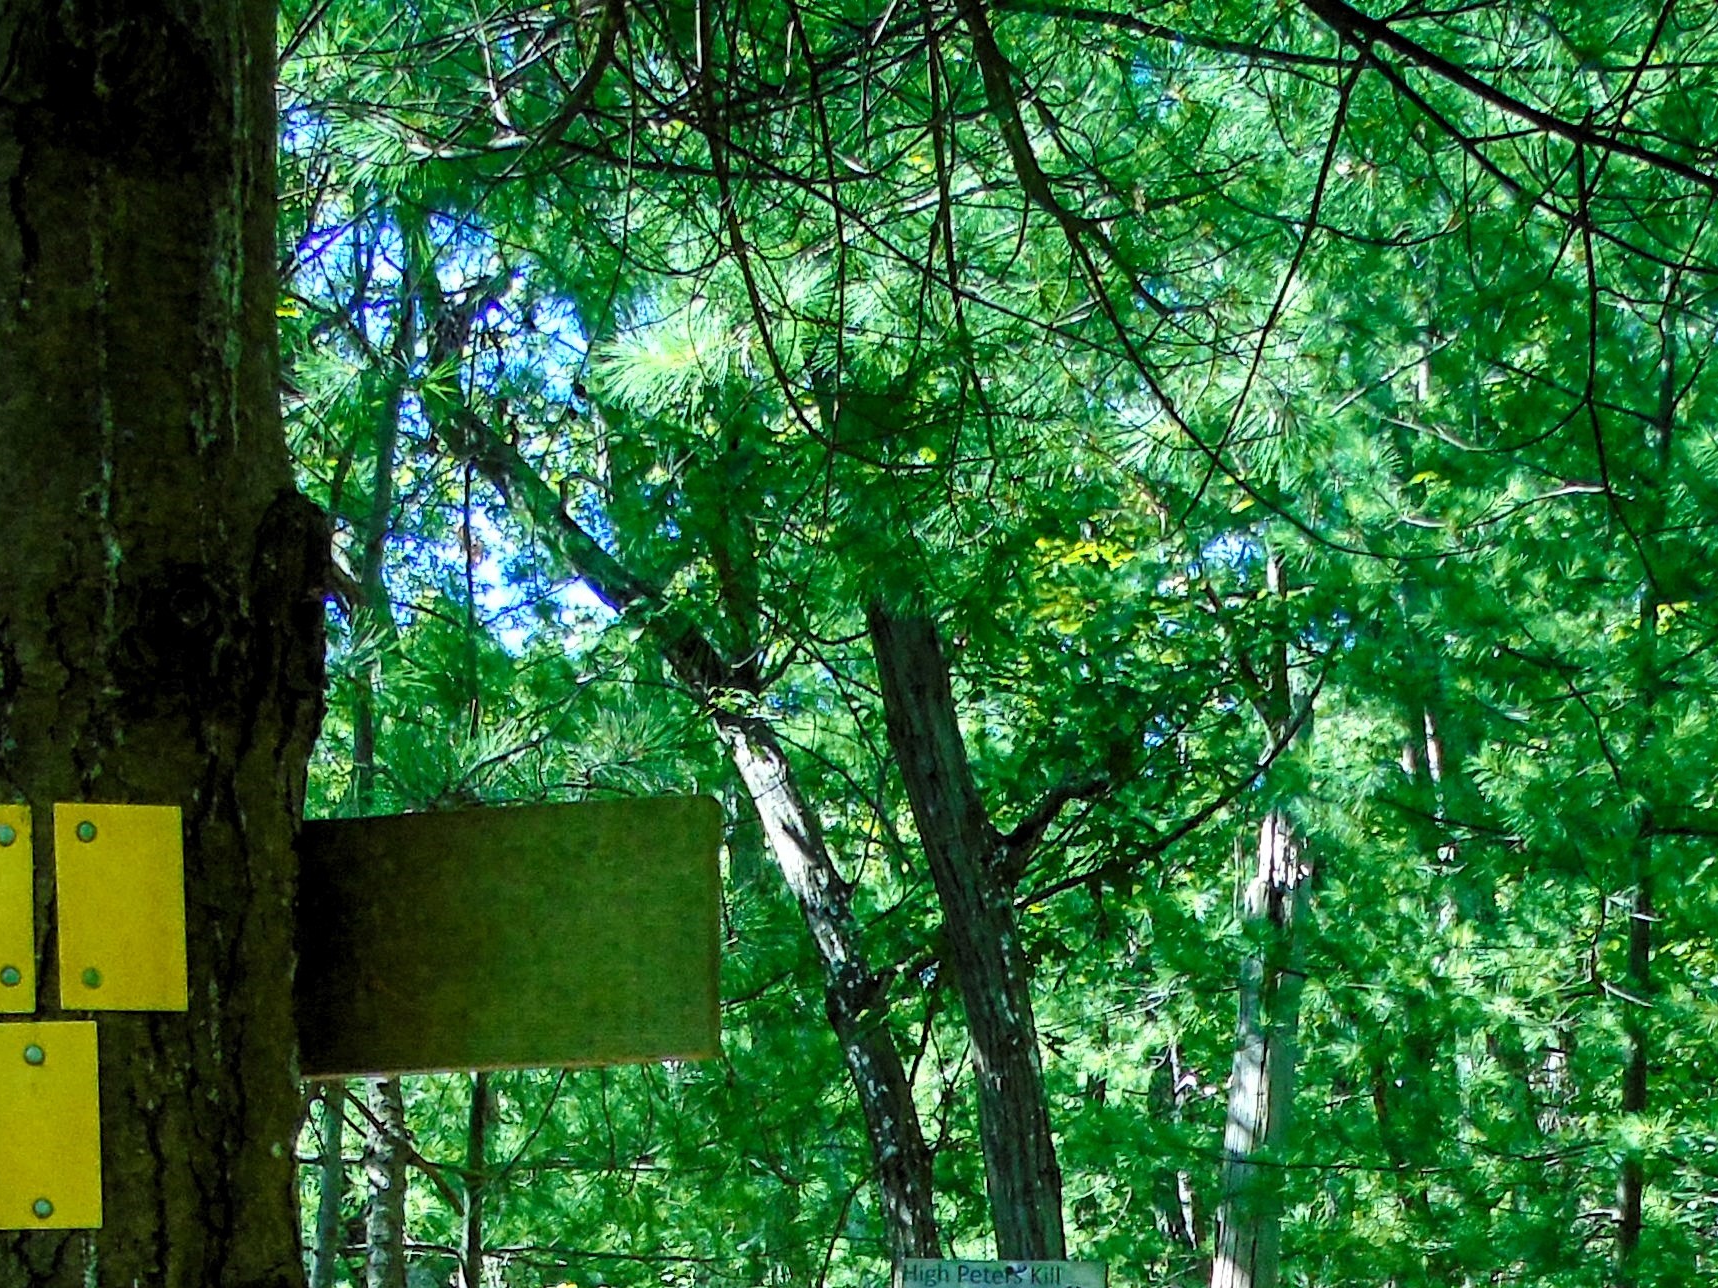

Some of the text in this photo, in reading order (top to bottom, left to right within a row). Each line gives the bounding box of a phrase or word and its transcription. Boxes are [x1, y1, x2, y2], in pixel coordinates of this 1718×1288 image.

[903, 1263, 1061, 1288] High Peters Kill
